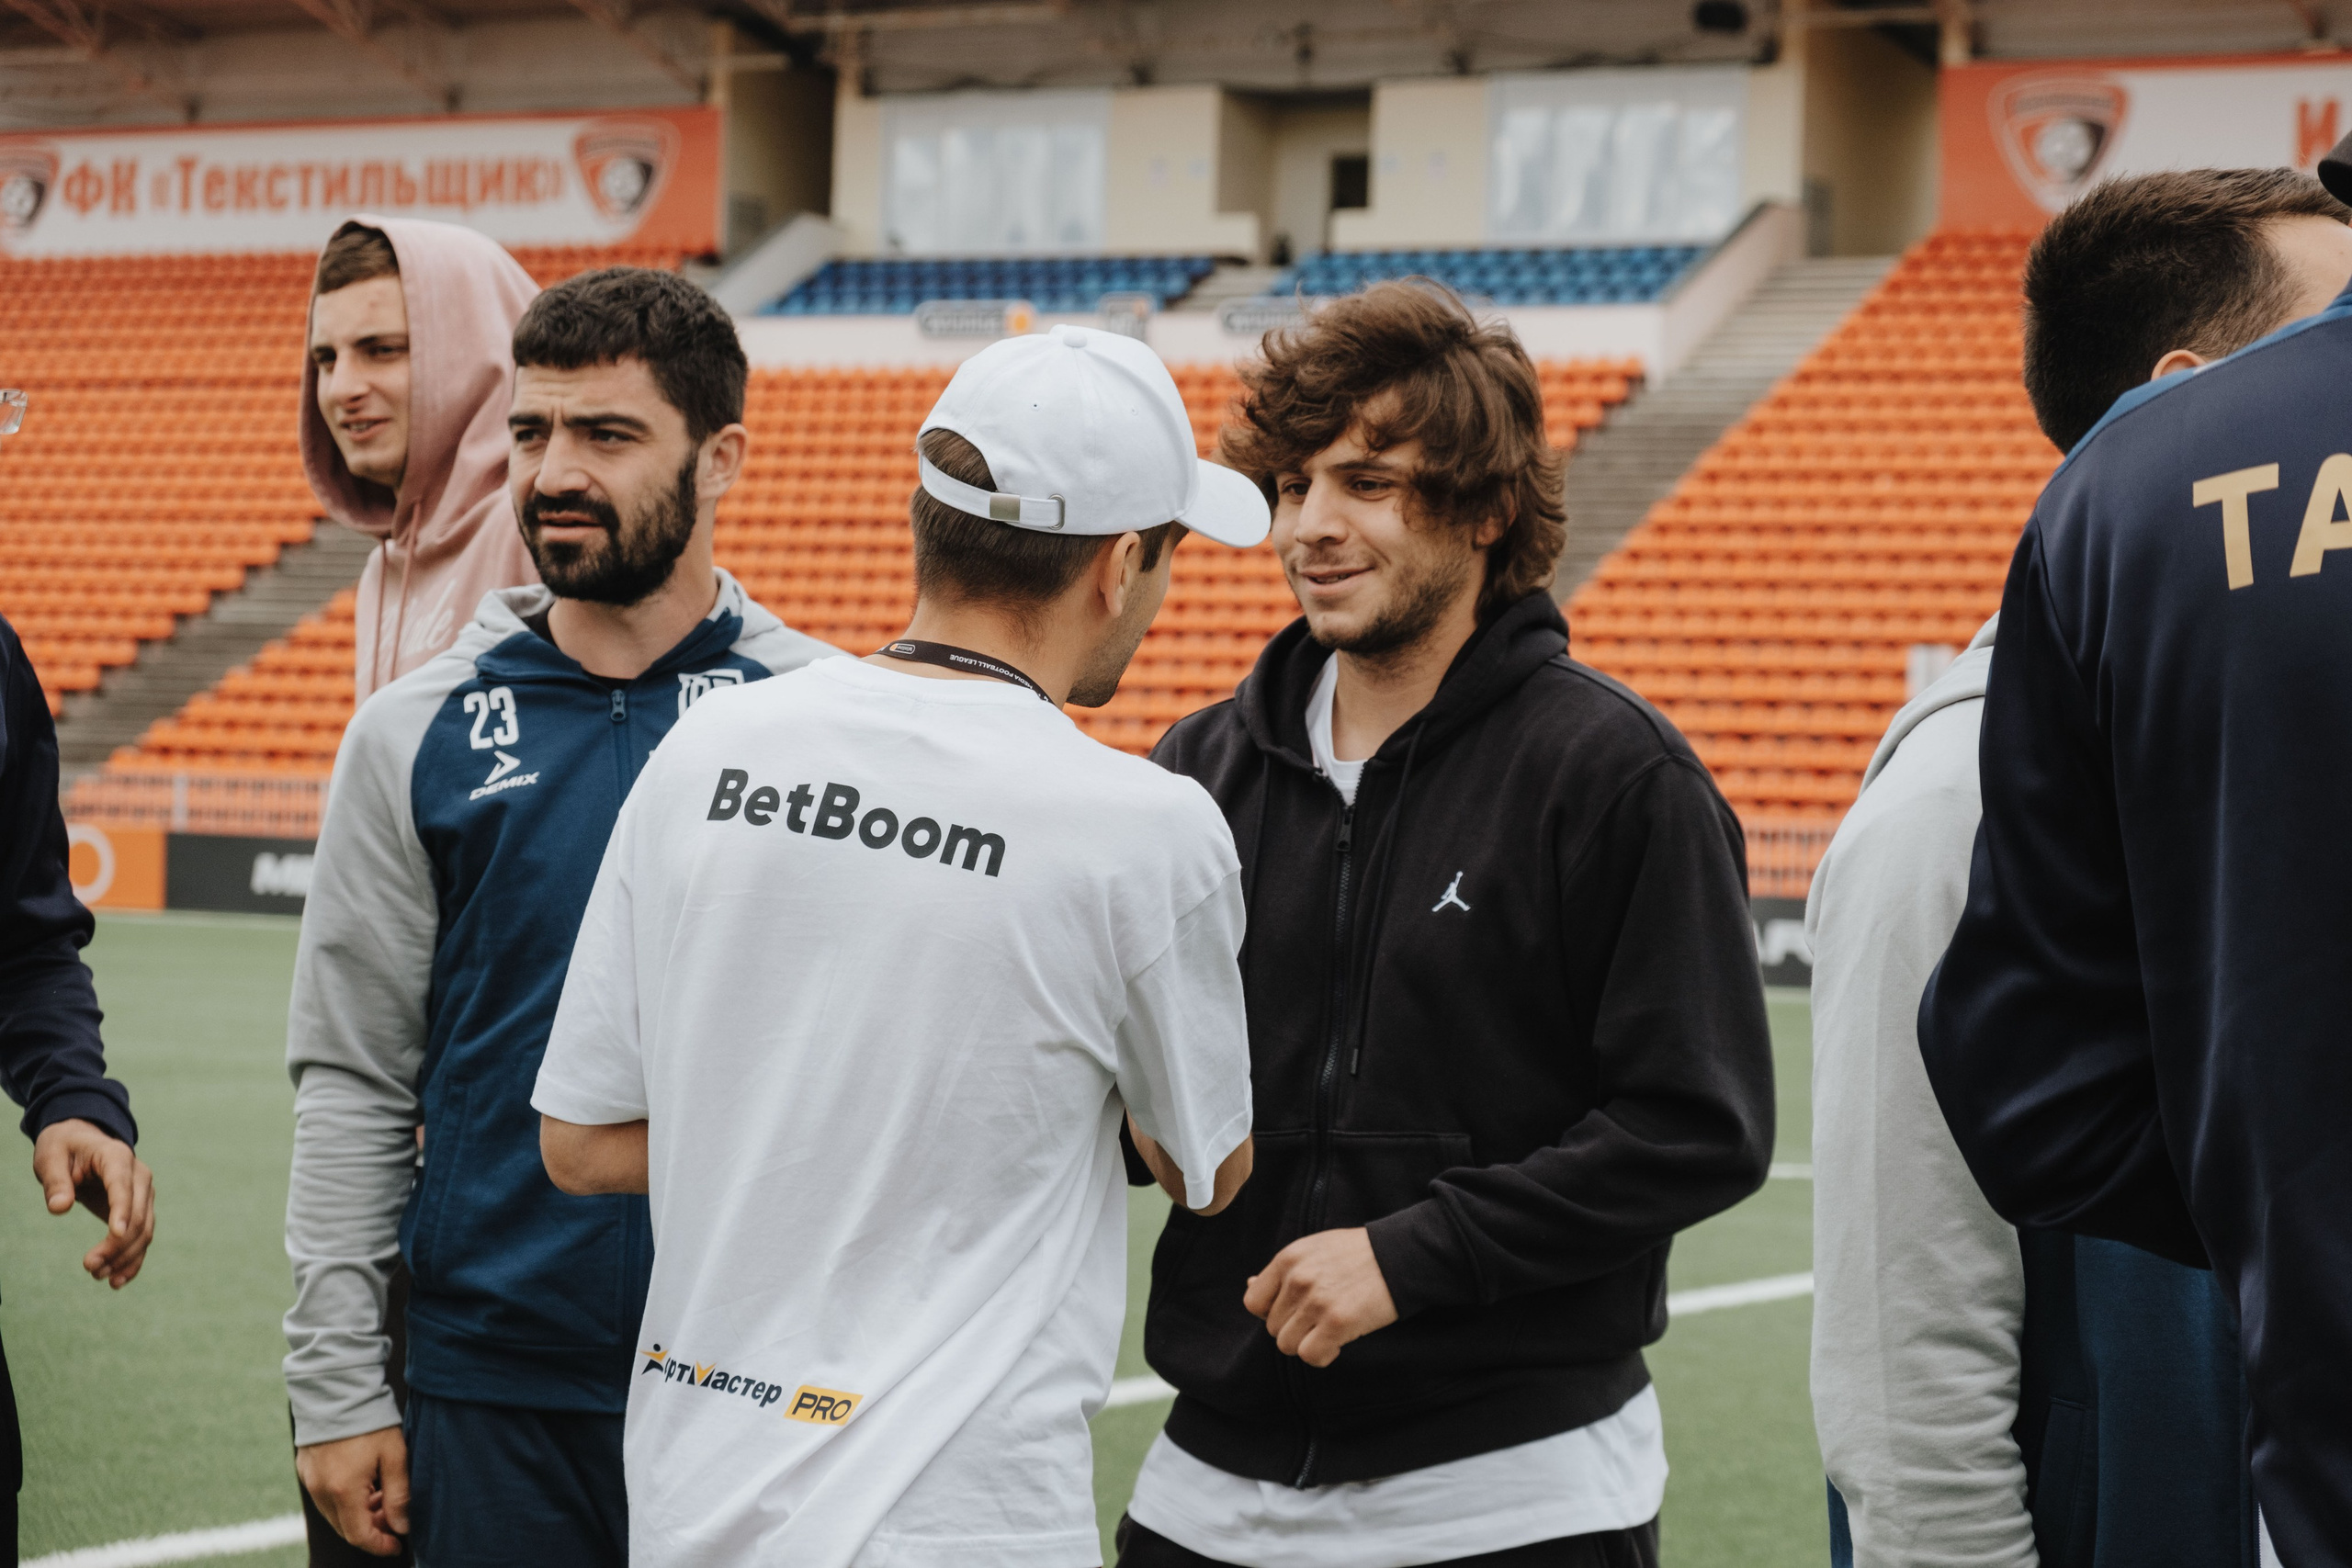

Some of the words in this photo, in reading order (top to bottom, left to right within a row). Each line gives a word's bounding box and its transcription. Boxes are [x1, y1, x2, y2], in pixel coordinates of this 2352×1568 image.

[61, 156, 138, 217] ФК
[949, 653, 978, 666] LEAGUE
[978, 660, 1013, 678] FOOTBALL
[463, 685, 520, 750] 23
[469, 771, 540, 801] DEMIX
[707, 768, 1006, 877] BetBoom
[791, 1392, 853, 1421] PRO
